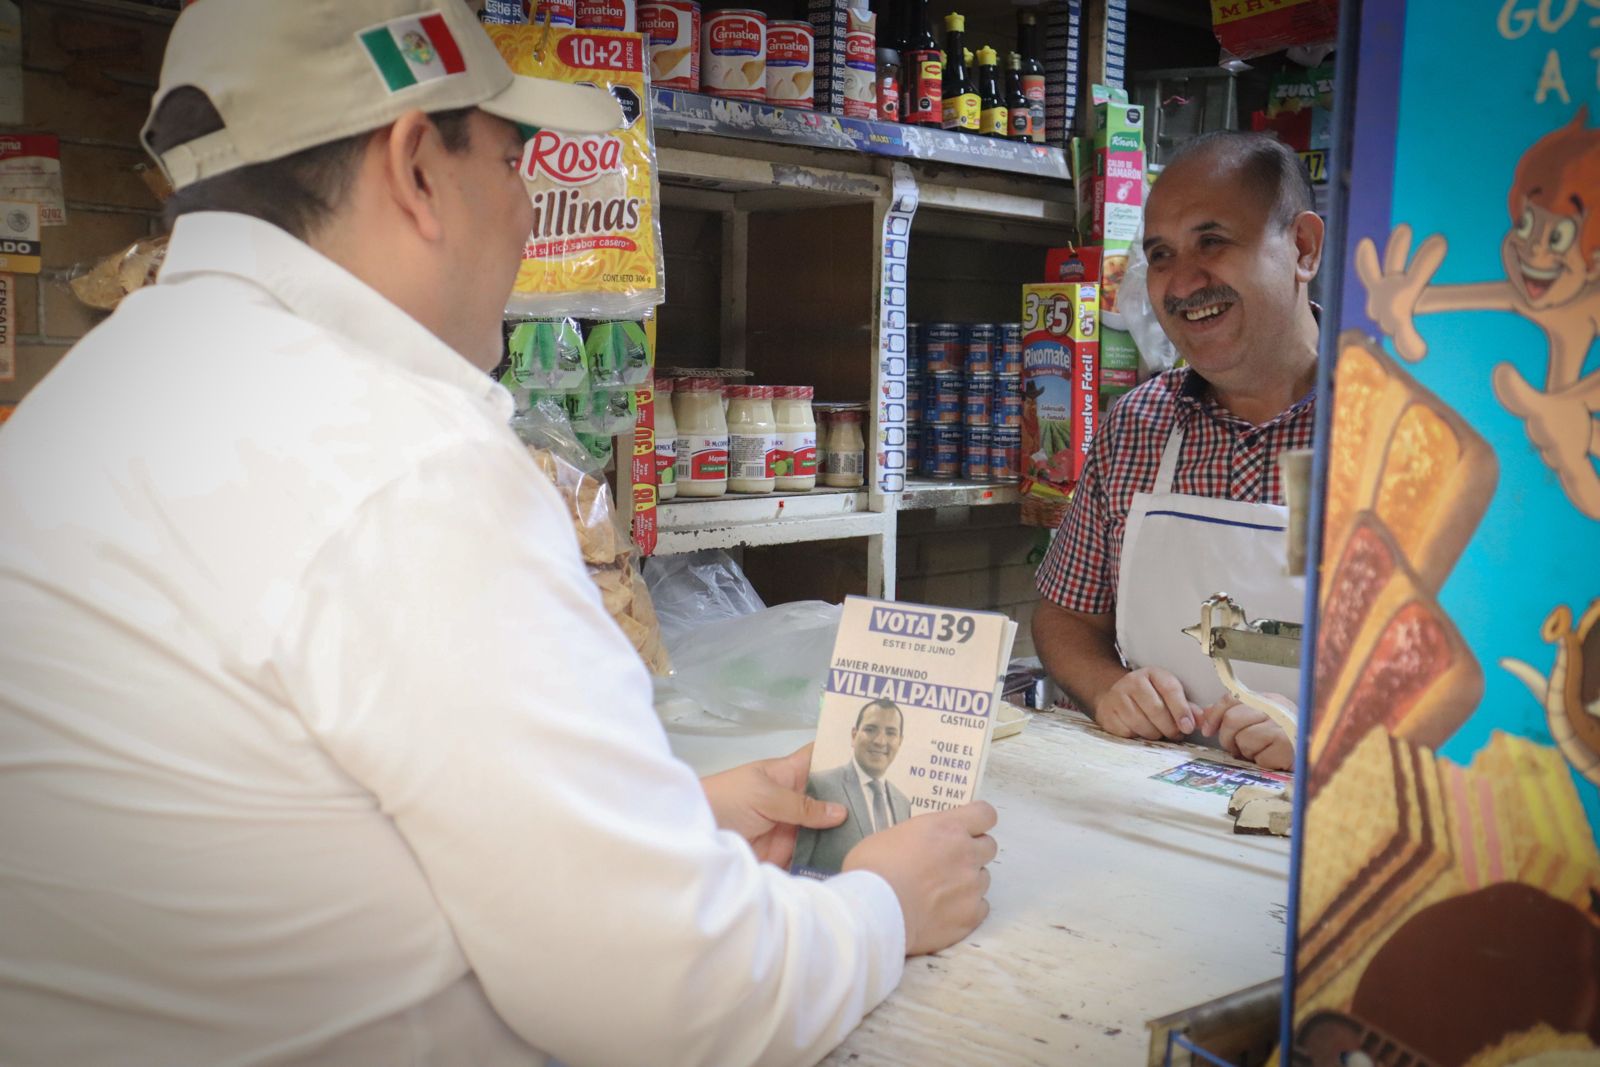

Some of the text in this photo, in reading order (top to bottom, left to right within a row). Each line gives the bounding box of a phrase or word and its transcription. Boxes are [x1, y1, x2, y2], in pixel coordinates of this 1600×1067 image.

[713, 25, 760, 42] Carnation
[570, 38, 622, 68] 10+2
[626, 41, 634, 69] PIEZAS
[1535, 48, 1570, 104] A
[527, 130, 621, 182] Rosa
[533, 189, 639, 239] illinas
[551, 242, 569, 253] rico
[570, 239, 596, 251] sabor
[599, 238, 627, 248] casero
[1024, 293, 1040, 329] 3
[1081, 354, 1093, 391] Fácil
[875, 609, 976, 644] VOTA 39
[882, 638, 956, 656] ESTE 1 DE JUNIO
[835, 657, 928, 680] JAVIER RAYMUNDO
[832, 670, 990, 716] VILLALPANDO
[940, 714, 985, 730] CASTILLO
[929, 754, 971, 771] DINERO
[962, 745, 974, 757] EL
[909, 765, 968, 785] NO DEFINA
[931, 785, 966, 800] SI HAY
